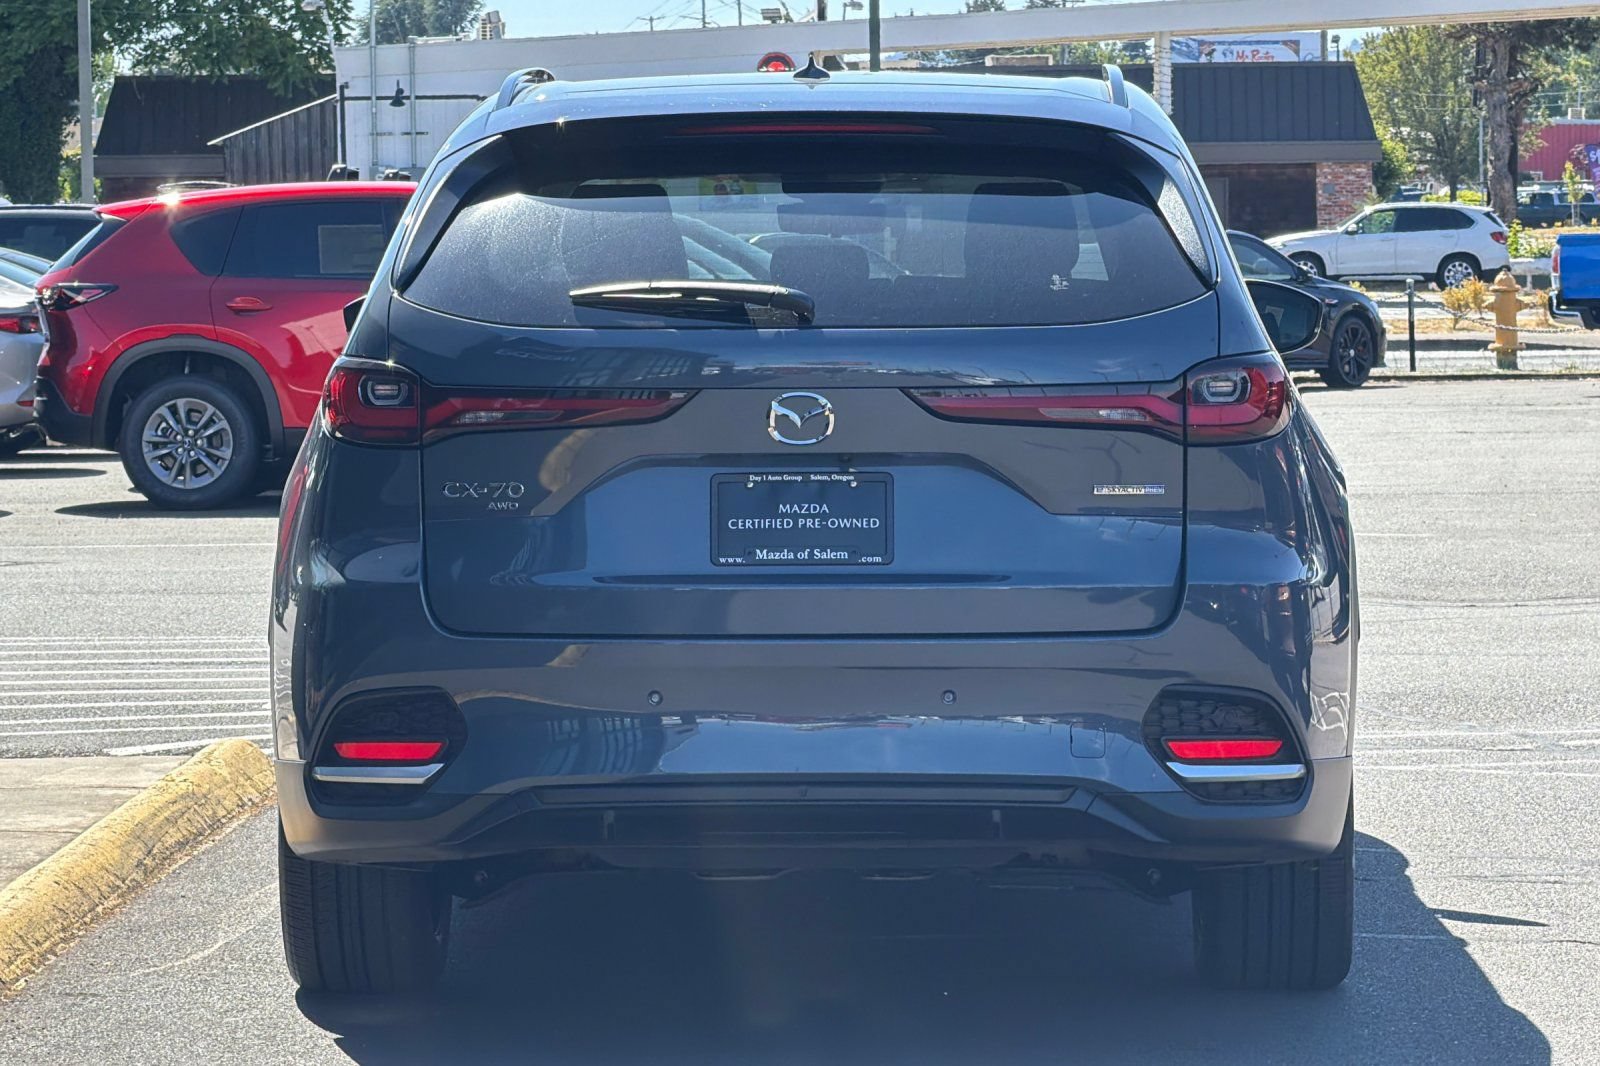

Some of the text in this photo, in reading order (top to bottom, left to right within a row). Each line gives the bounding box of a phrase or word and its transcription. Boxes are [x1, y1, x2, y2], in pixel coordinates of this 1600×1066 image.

[749, 474, 761, 482] Day
[783, 474, 803, 482] Group
[810, 474, 830, 482] Salem,
[831, 474, 854, 482] Oregon
[442, 481, 525, 498] CX-70
[487, 501, 519, 511] AWD
[778, 503, 830, 514] MAZDA
[728, 517, 880, 530] CERTIFIED PRE-OWNED
[755, 549, 794, 560] Mazda
[797, 549, 809, 560] of
[813, 549, 848, 560] Salem
[858, 555, 882, 563] .com
